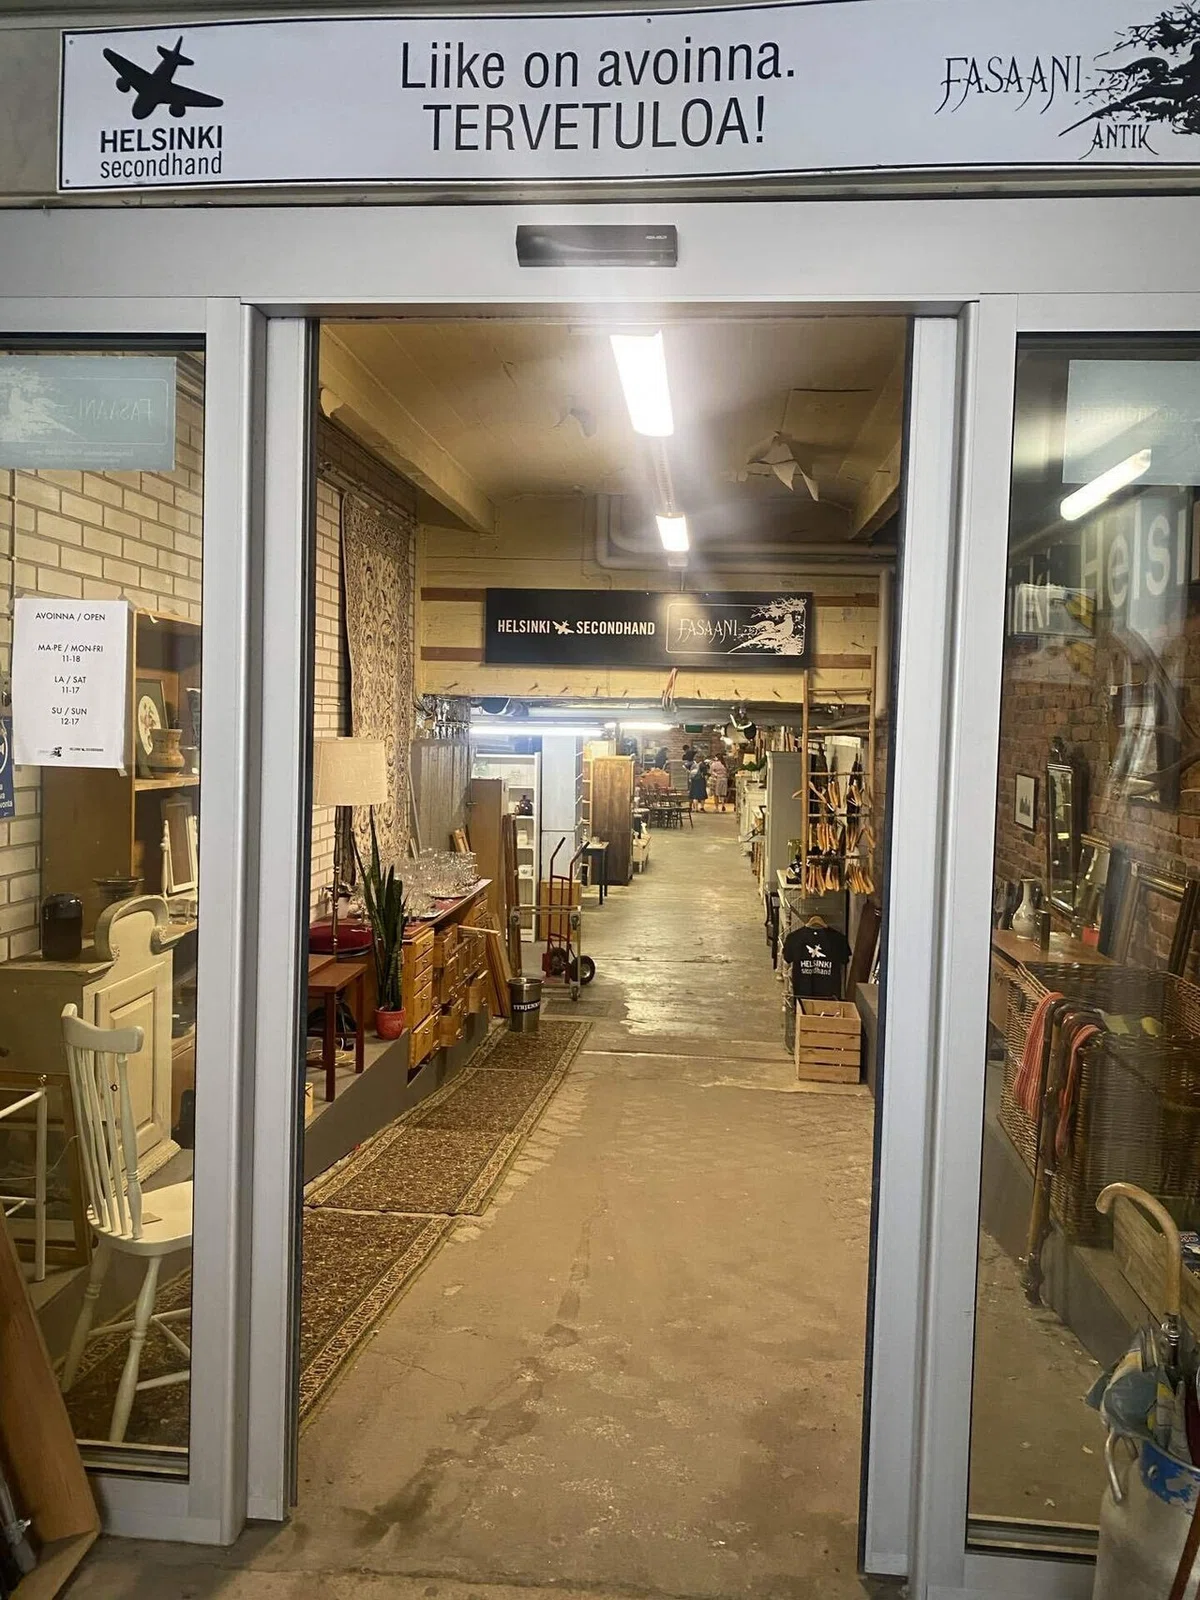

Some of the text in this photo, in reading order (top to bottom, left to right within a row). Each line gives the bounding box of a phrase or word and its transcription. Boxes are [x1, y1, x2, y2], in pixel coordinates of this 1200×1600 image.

[401, 37, 795, 89] Liike on avoinna.
[934, 55, 1082, 114] FASAANI
[422, 96, 765, 151] TERVETULOA!
[100, 125, 223, 153] HELSINKI
[1078, 121, 1160, 160] ANTIK
[100, 151, 222, 179] secondhand
[35, 612, 75, 621] AVOINNA
[83, 613, 106, 621] OPEN
[497, 619, 656, 636] HELSINKI SECONDHAND
[677, 617, 739, 644] FASAANI
[37, 644, 62, 652] MA-PE
[62, 654, 81, 663] 11-18
[54, 676, 65, 684] LA
[72, 676, 87, 684] SAT
[61, 686, 80, 694] 11-17
[51, 706, 63, 715] SU
[71, 707, 88, 716] SUN
[60, 717, 80, 726] 12-17
